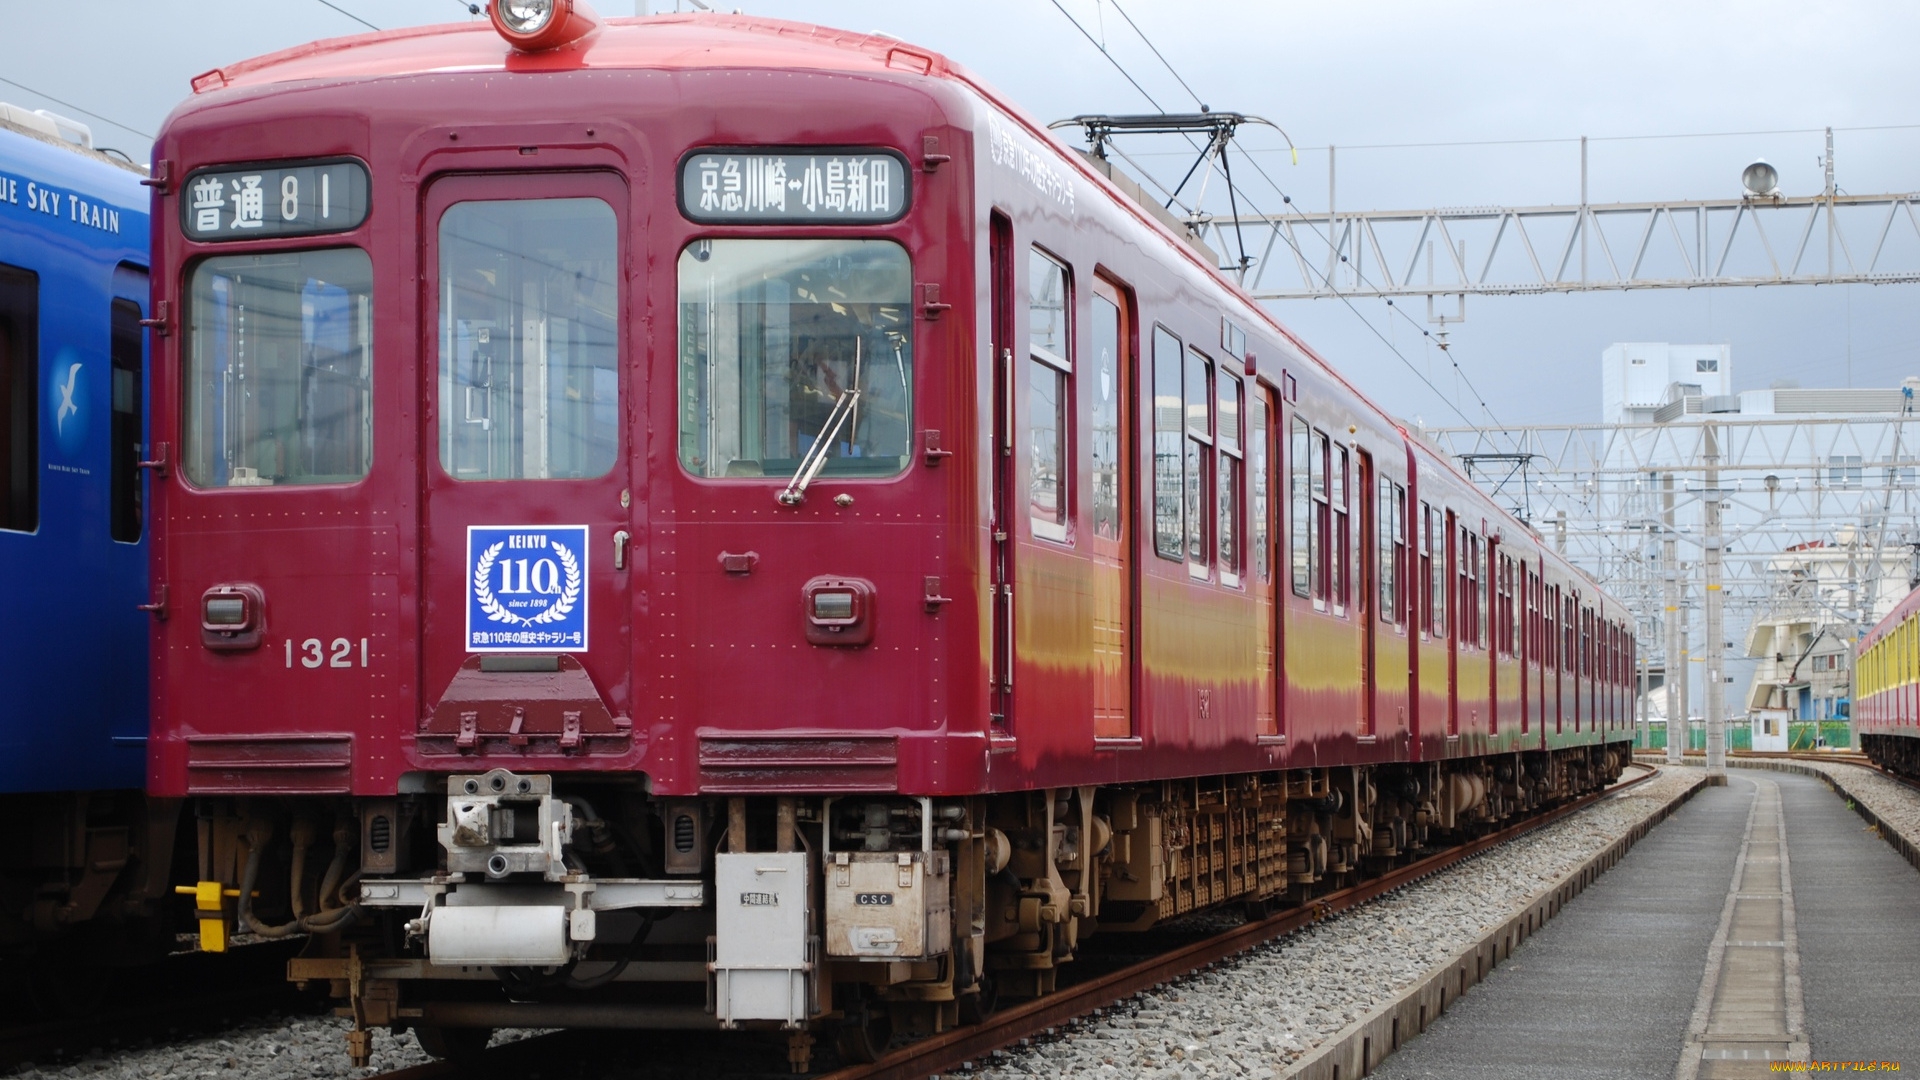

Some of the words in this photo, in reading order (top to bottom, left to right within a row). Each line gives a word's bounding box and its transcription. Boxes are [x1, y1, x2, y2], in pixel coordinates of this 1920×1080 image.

[27, 181, 60, 217] SKY
[69, 194, 119, 234] TRAIN
[193, 175, 263, 231] 普通
[508, 534, 547, 549] KEIKYU
[508, 599, 529, 608] since
[530, 598, 548, 608] 1898
[472, 631, 582, 645] 京急110年の歴史ギャラリー号
[285, 637, 368, 669] 1321
[860, 894, 888, 904] CSC
